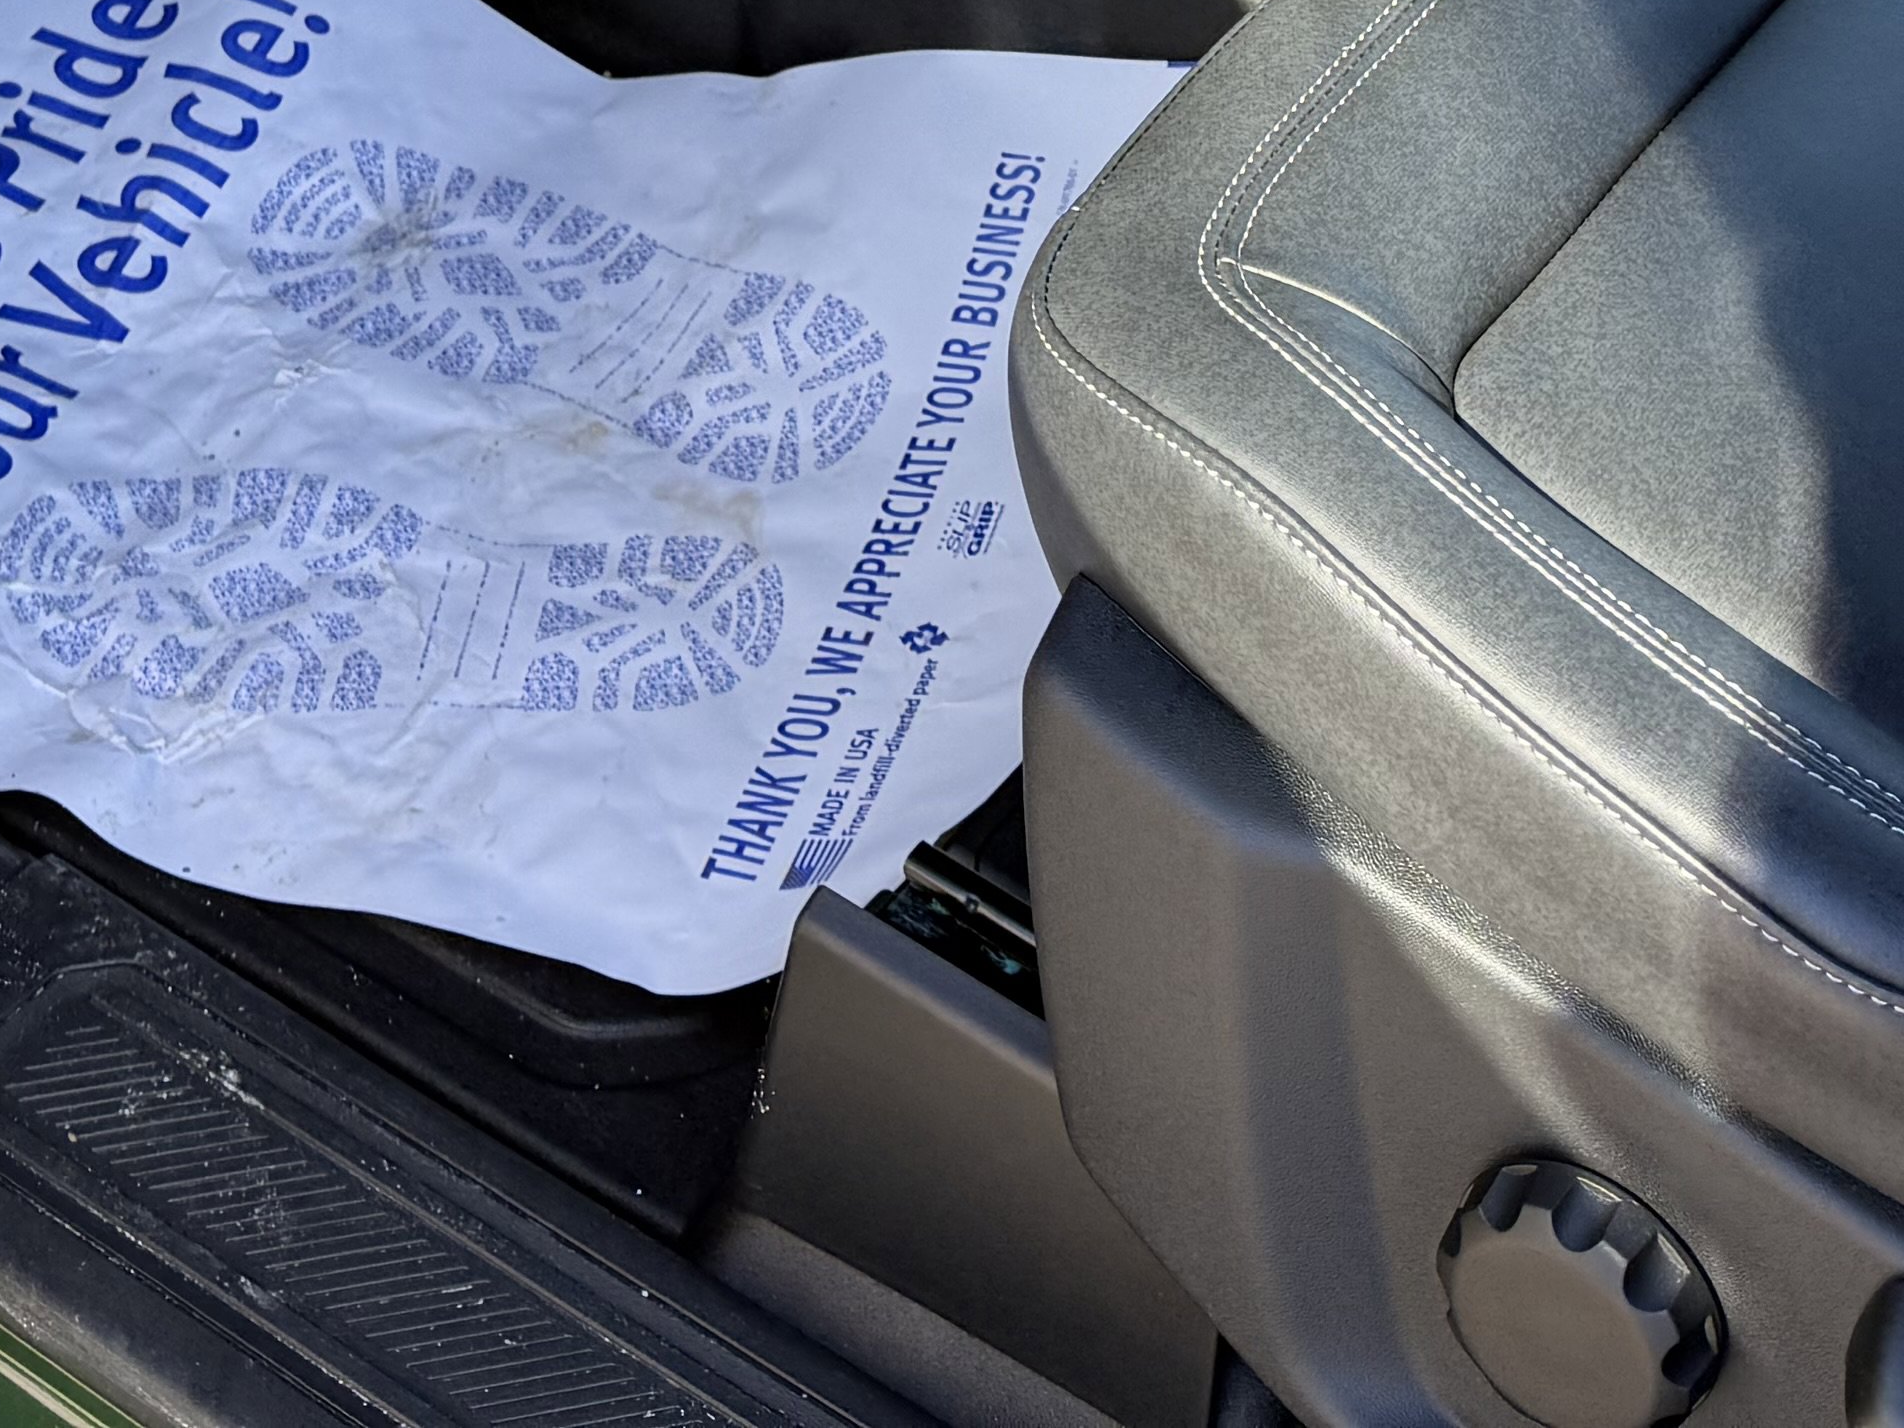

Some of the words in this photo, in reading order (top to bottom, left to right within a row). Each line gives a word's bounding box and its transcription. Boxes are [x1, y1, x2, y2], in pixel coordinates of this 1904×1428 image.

[952, 151, 1046, 328] BUSINESS!
[916, 337, 992, 429] YOUR
[836, 437, 956, 622] APPRECIATE
[946, 500, 971, 552] SLIP
[805, 626, 875, 675] WE
[763, 687, 857, 758] YOU,
[842, 796, 872, 837] From
[865, 698, 920, 800] landfill-diverted
[913, 658, 940, 696] paper
[845, 727, 880, 761] USA
[834, 765, 861, 784] IN
[700, 765, 808, 882] THANK
[808, 789, 850, 837] MADE
